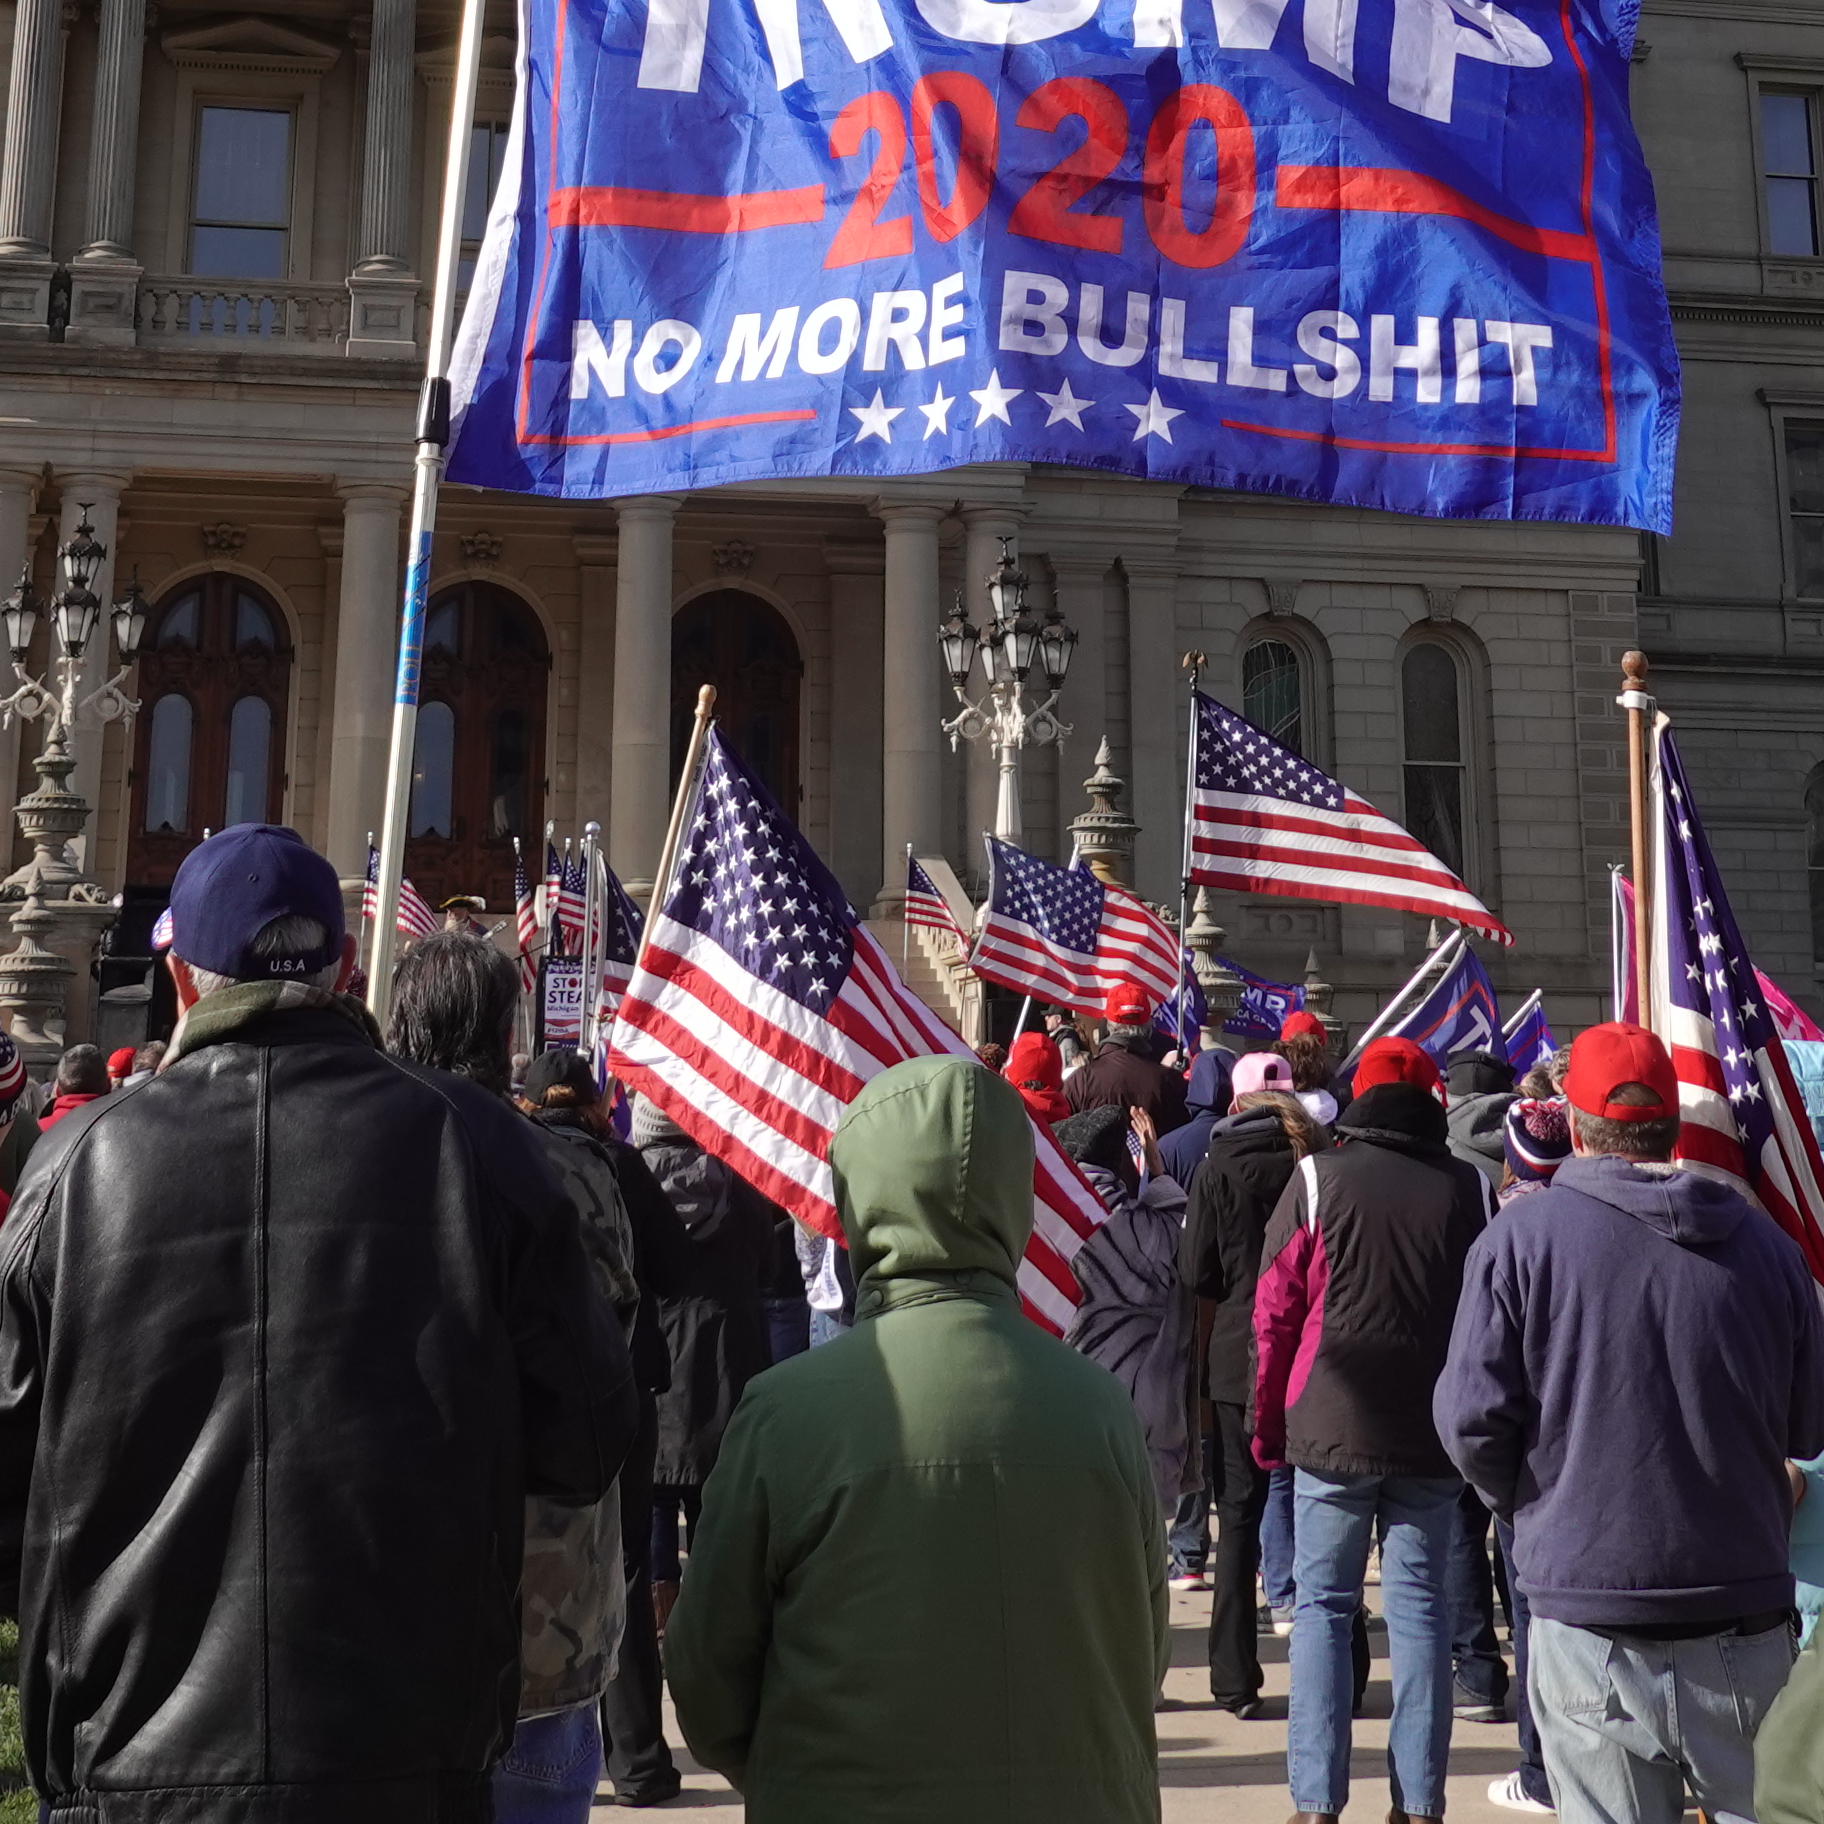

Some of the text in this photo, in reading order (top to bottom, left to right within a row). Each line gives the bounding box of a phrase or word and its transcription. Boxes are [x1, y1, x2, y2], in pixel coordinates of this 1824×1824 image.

[823, 71, 1256, 270] 2020
[571, 270, 1554, 407] NO MORE BULLSHIT
[270, 958, 306, 973] U.S.A
